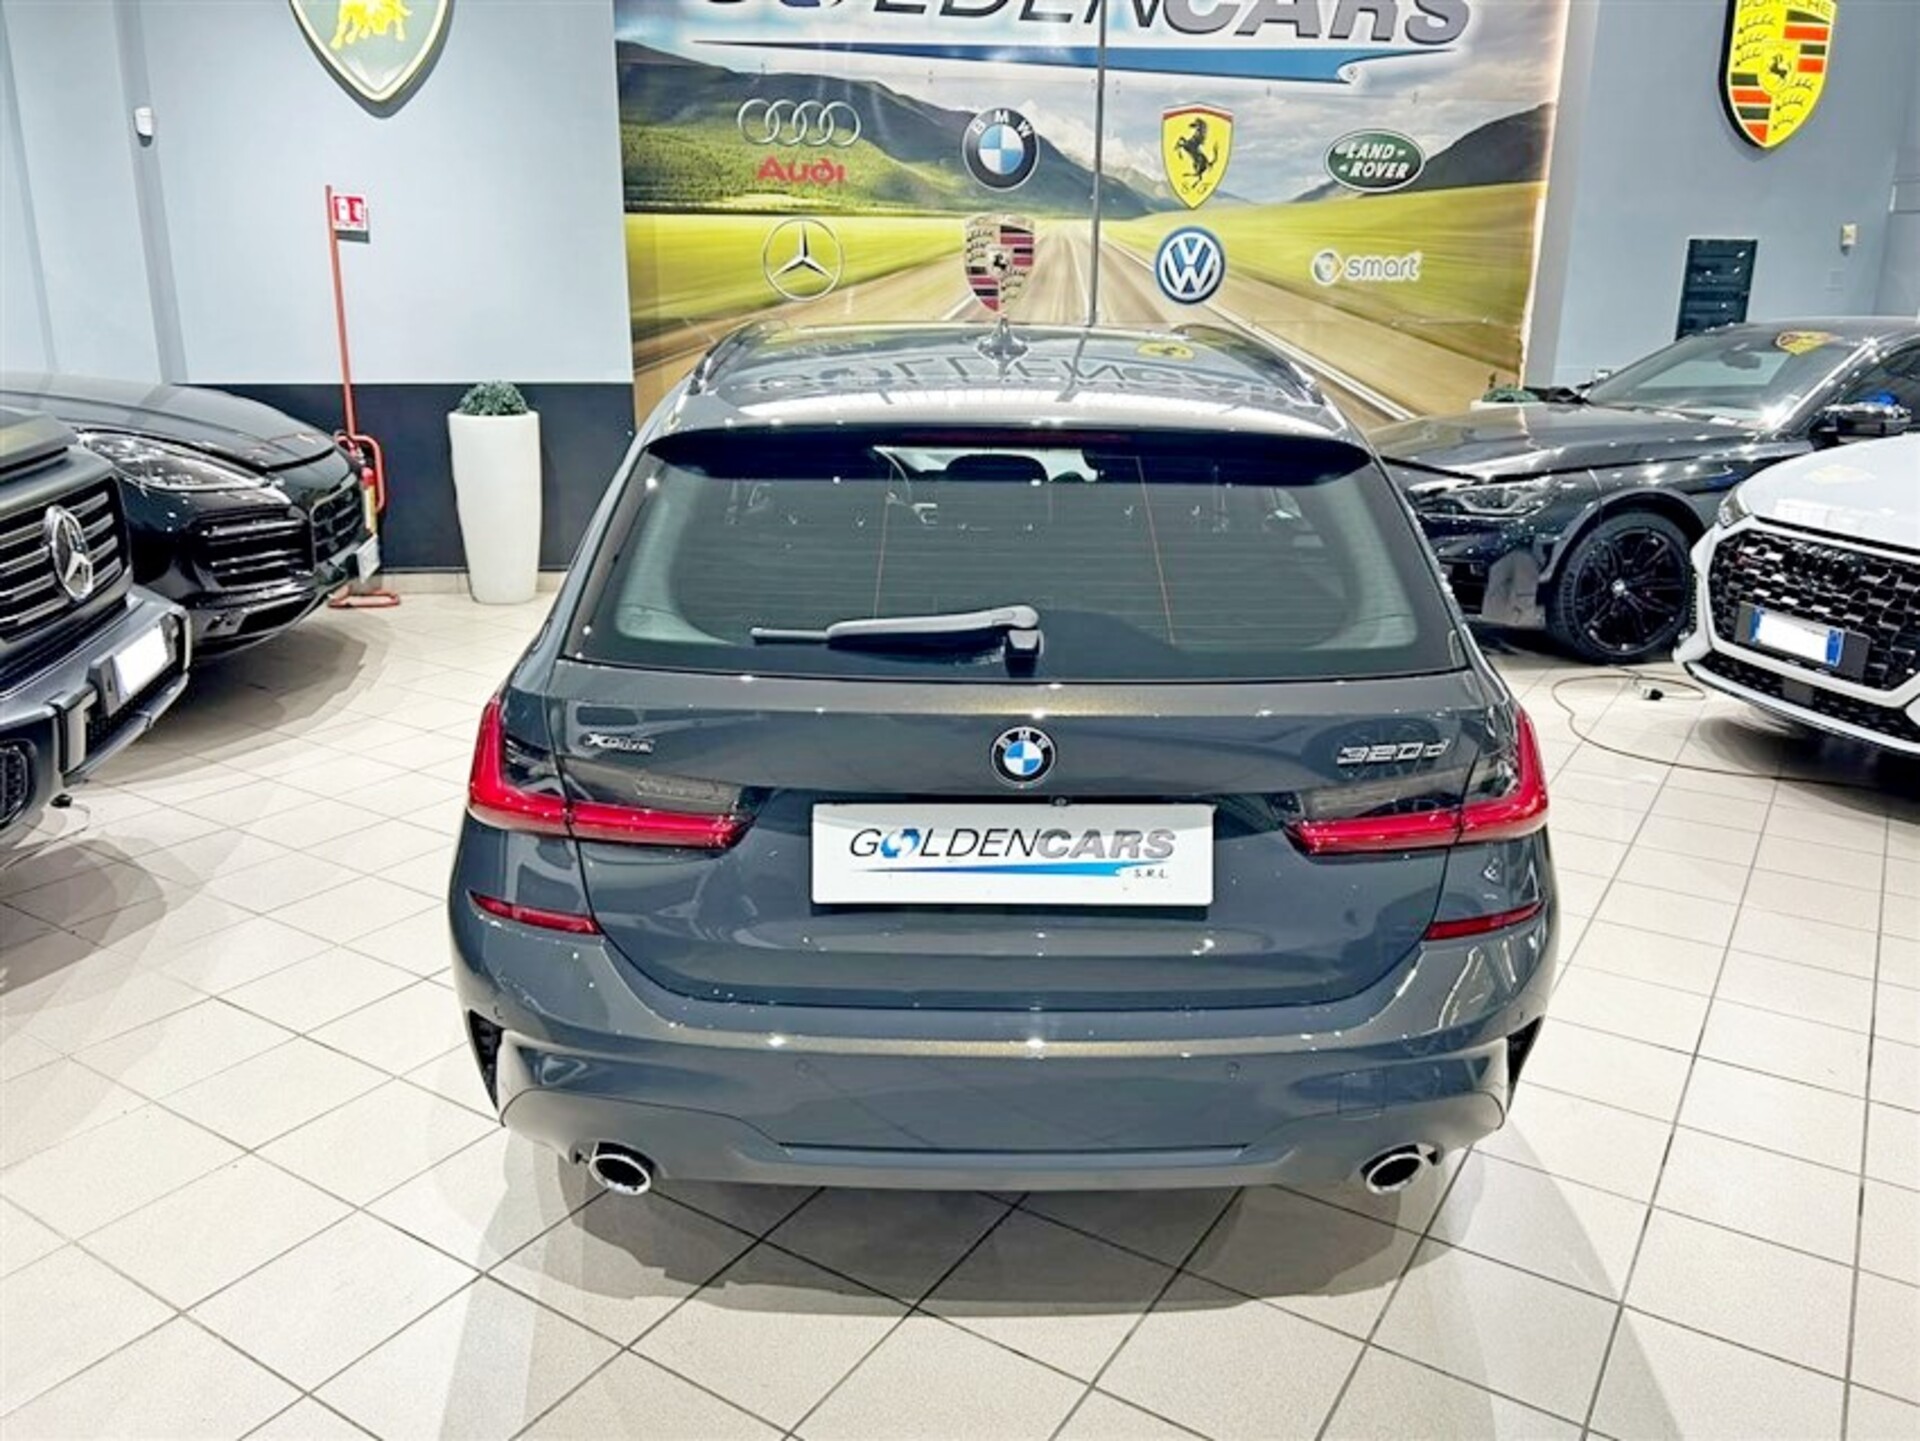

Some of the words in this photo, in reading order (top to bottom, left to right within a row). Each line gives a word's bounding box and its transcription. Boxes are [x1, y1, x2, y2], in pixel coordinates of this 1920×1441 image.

[972, 109, 1036, 137] BMW
[1346, 141, 1397, 159] LAND
[757, 156, 845, 185] Audi
[1351, 162, 1409, 180] ROVER
[1347, 252, 1420, 280] smart
[1337, 739, 1450, 765] 320d
[849, 828, 1176, 859] GOLDENCARS
